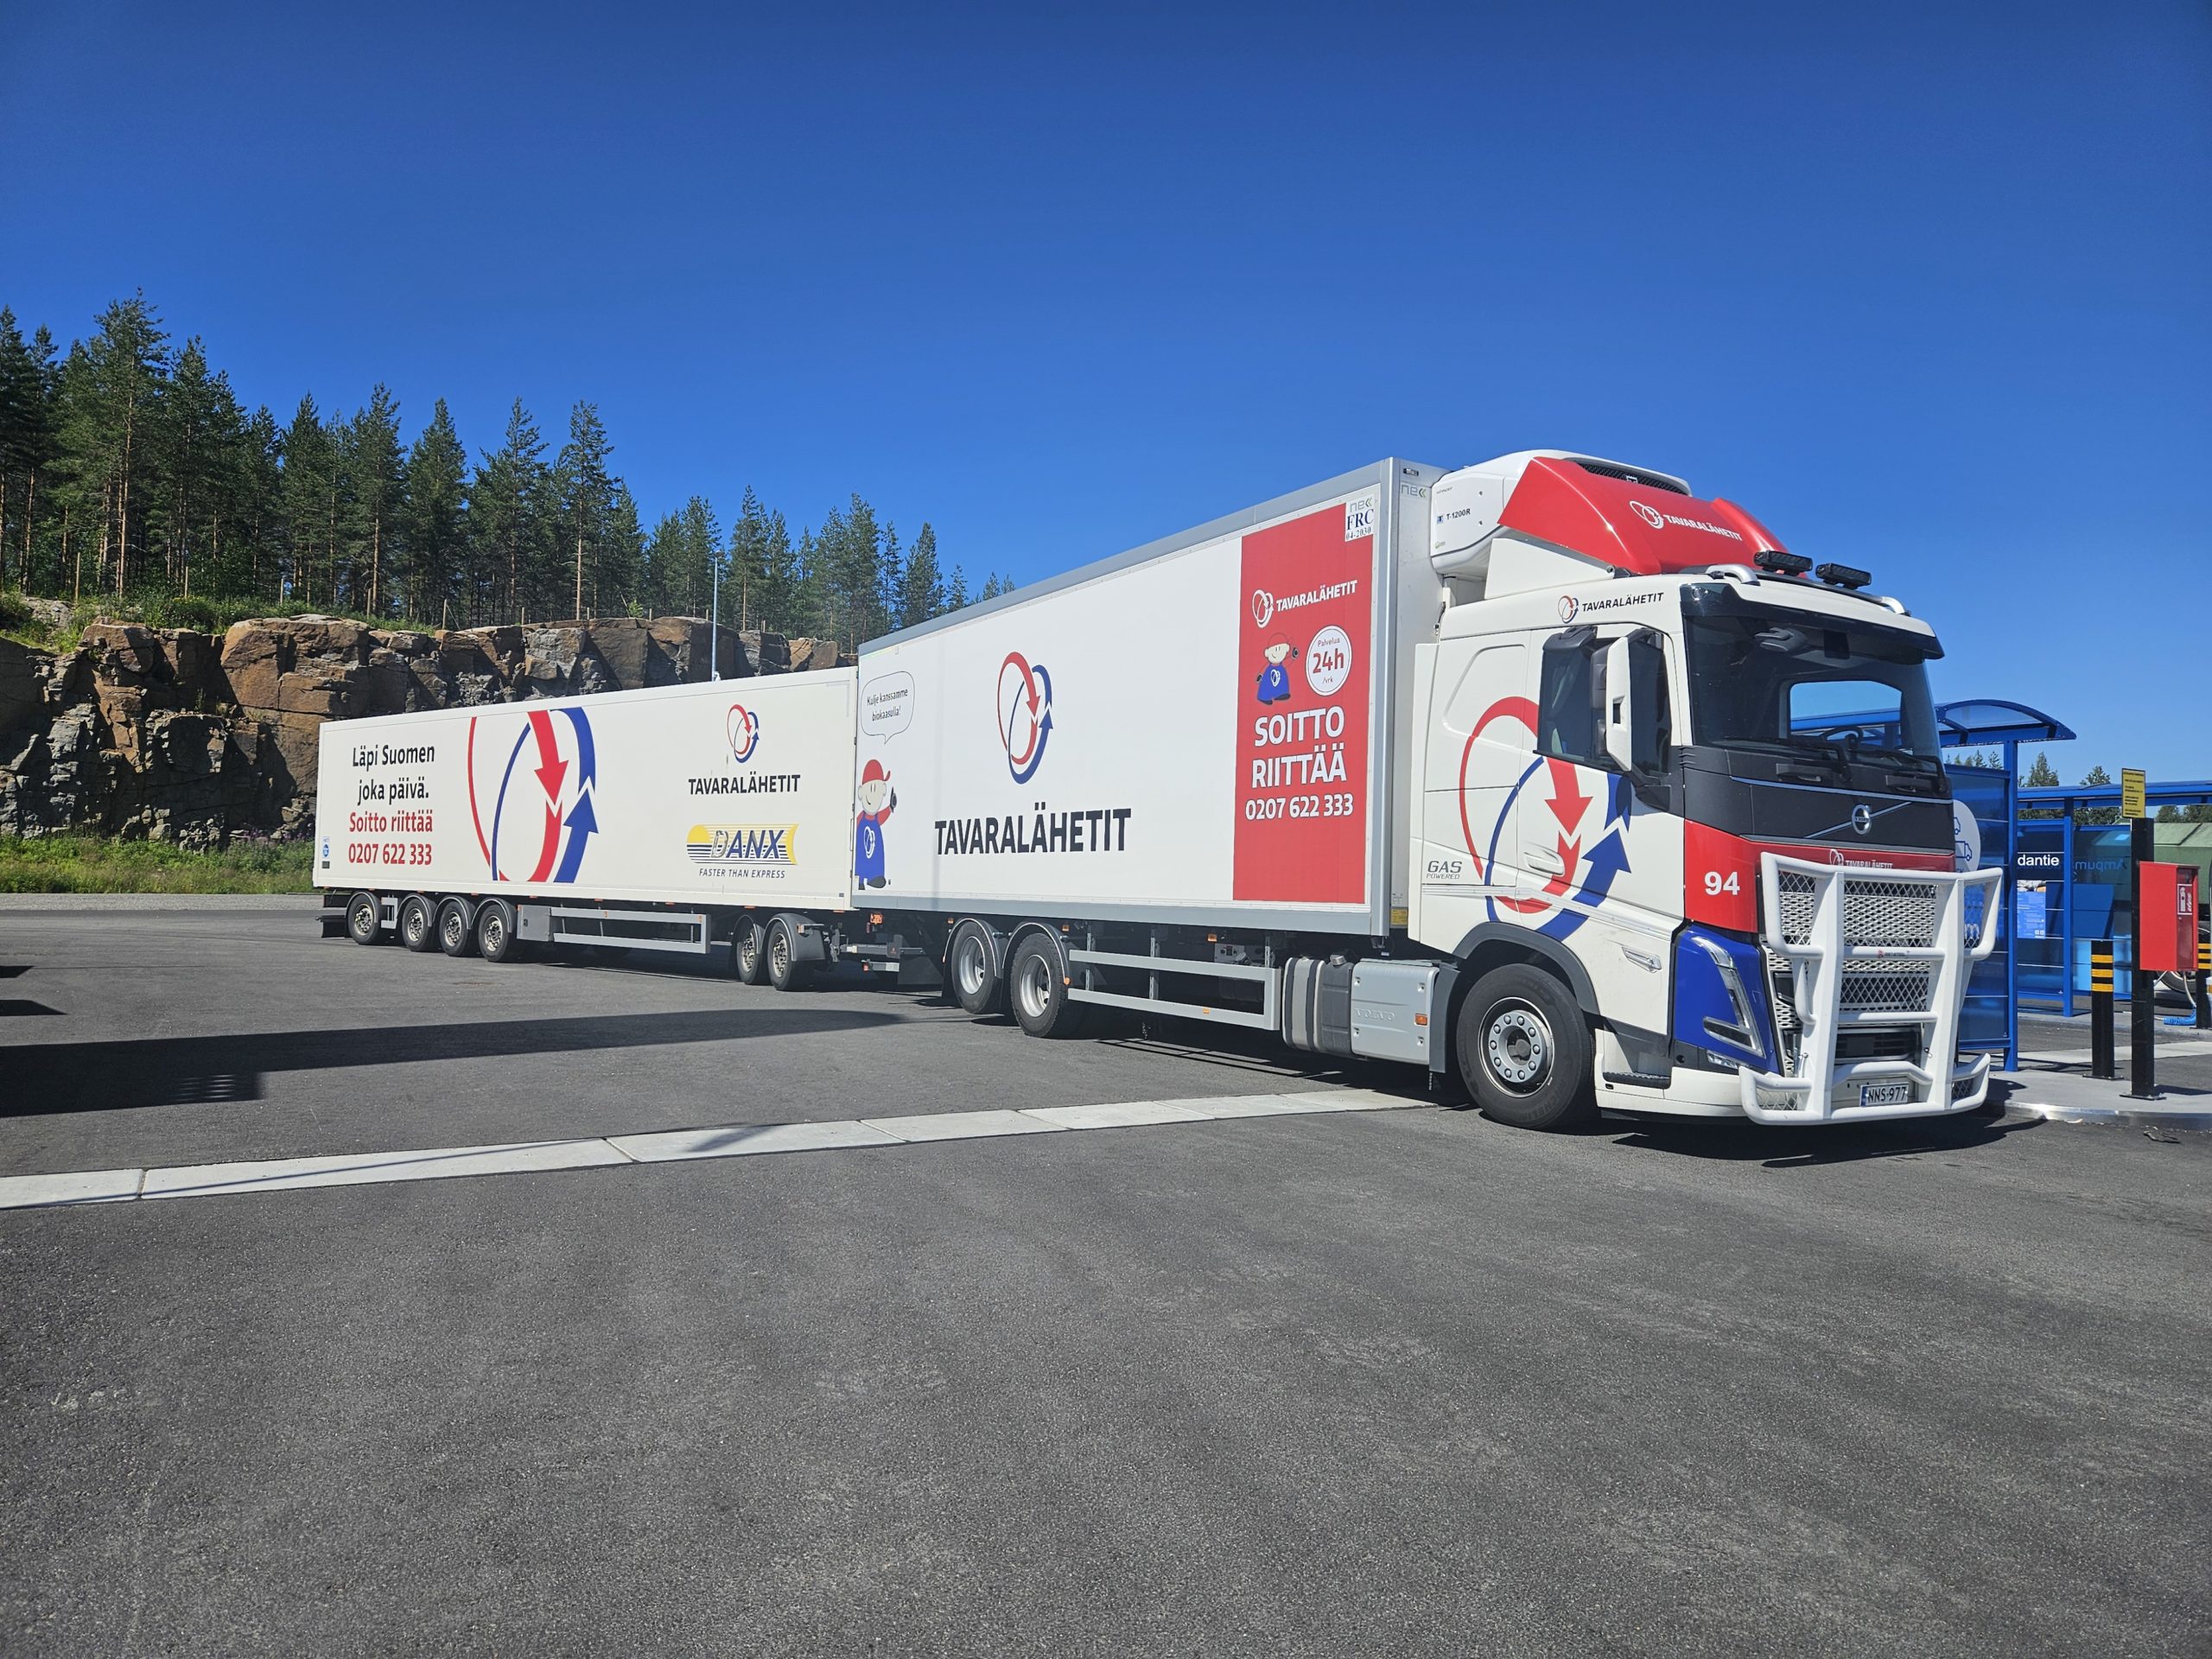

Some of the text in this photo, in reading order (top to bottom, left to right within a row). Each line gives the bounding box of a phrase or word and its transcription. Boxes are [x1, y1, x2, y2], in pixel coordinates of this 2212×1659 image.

[1347, 508, 1374, 531] FRC
[1446, 508, 1471, 520] T-1200R
[1346, 526, 1371, 540] 04-2030
[1662, 514, 1743, 541] TAVARALÄHETIT
[1276, 580, 1357, 612] TAVARALÄHETIT
[1582, 592, 1664, 612] TAVARALÄHETIT
[1313, 648, 1344, 674] 24h
[1255, 706, 1344, 747] SOITTO
[353, 744, 435, 772] Läpi Suomen
[1252, 742, 1347, 788] RIITTÄÄ
[357, 776, 429, 806] joka päivä.
[689, 771, 801, 795] TAVARALÄHETIT
[1245, 793, 1354, 821] 0207 622 333
[349, 809, 433, 832] Soitto riittää
[935, 802, 1132, 855] TAVARALÄHETIT
[348, 843, 432, 866] 0207 622 333
[711, 830, 785, 859] DANX
[699, 868, 785, 879] FASTER THAN EXPRESS
[1427, 861, 1463, 873] GAS
[1705, 871, 1741, 896] 94
[1868, 1086, 1907, 1103] NNS-977
